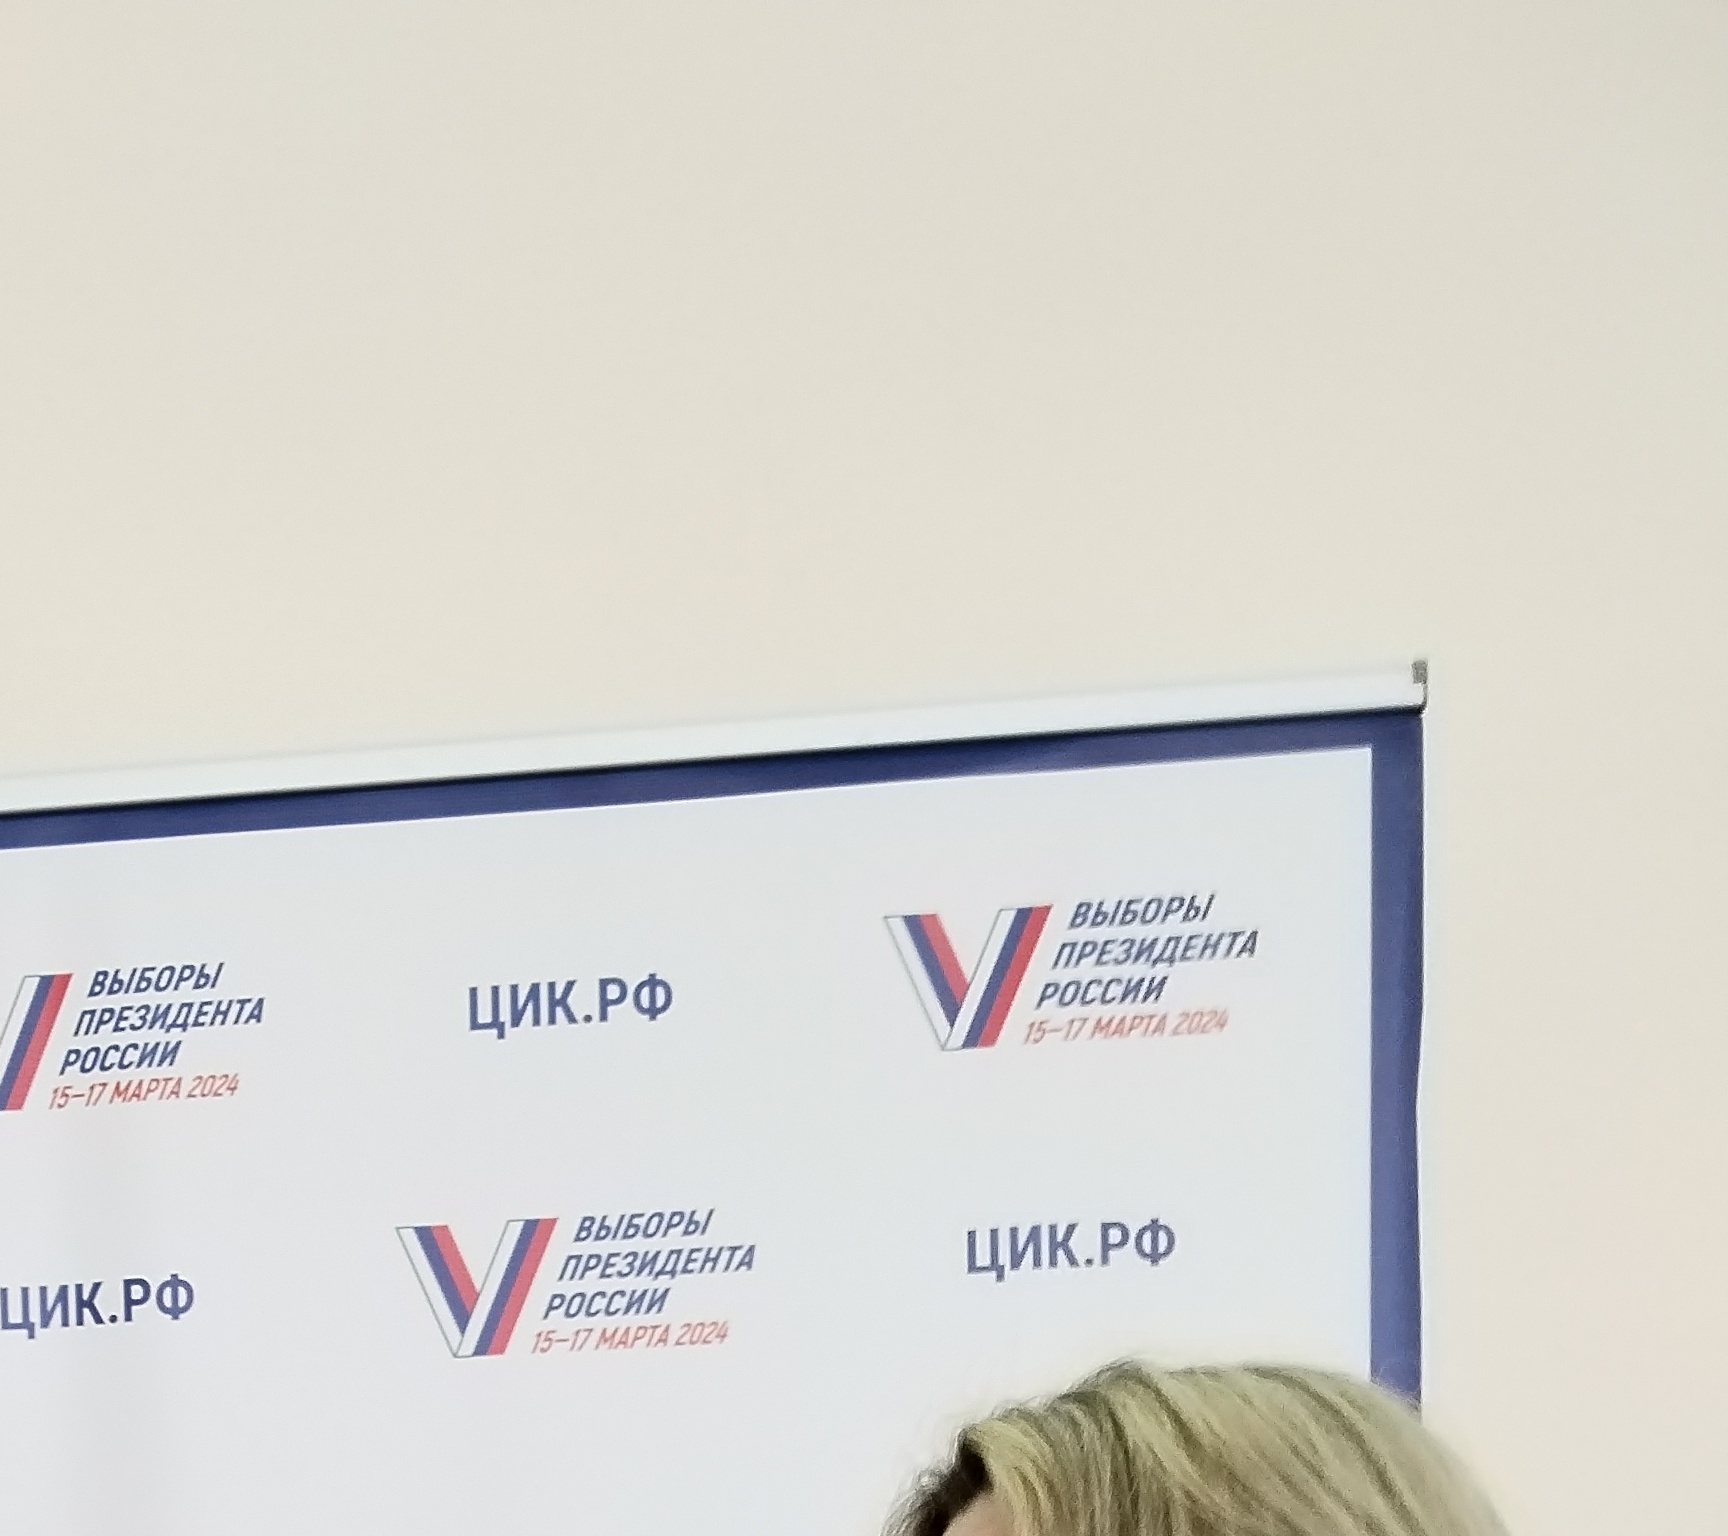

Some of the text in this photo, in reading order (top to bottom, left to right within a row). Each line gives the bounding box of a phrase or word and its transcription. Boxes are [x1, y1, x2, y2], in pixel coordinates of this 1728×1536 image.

[1067, 893, 1216, 930] ВЫБОРЫ
[1052, 929, 1258, 970] ПРЕЗИДЕНТА
[87, 962, 225, 998] ВЫБОРЫ
[1034, 974, 1169, 1010] РОССИИ
[73, 997, 266, 1037] ПРЕЗИДЕНТА
[469, 973, 673, 1040] ЦИК.РФ
[1089, 1013, 1168, 1039] МАРТА
[1170, 1009, 1228, 1036] 2024
[59, 1040, 183, 1076] РОССИИ
[108, 1077, 183, 1104] МАРТА
[186, 1073, 239, 1099] 2024
[573, 1208, 715, 1243] ВЫБОРЫ
[557, 1244, 756, 1282] ПРЕЗИДЕНТА
[967, 1218, 1175, 1283] ЦИК.РФ
[0, 1273, 194, 1340] ЦИК.РФ
[542, 1287, 671, 1320] РОССИИ
[594, 1324, 671, 1350] МАРТА
[673, 1320, 728, 1346] 2024
